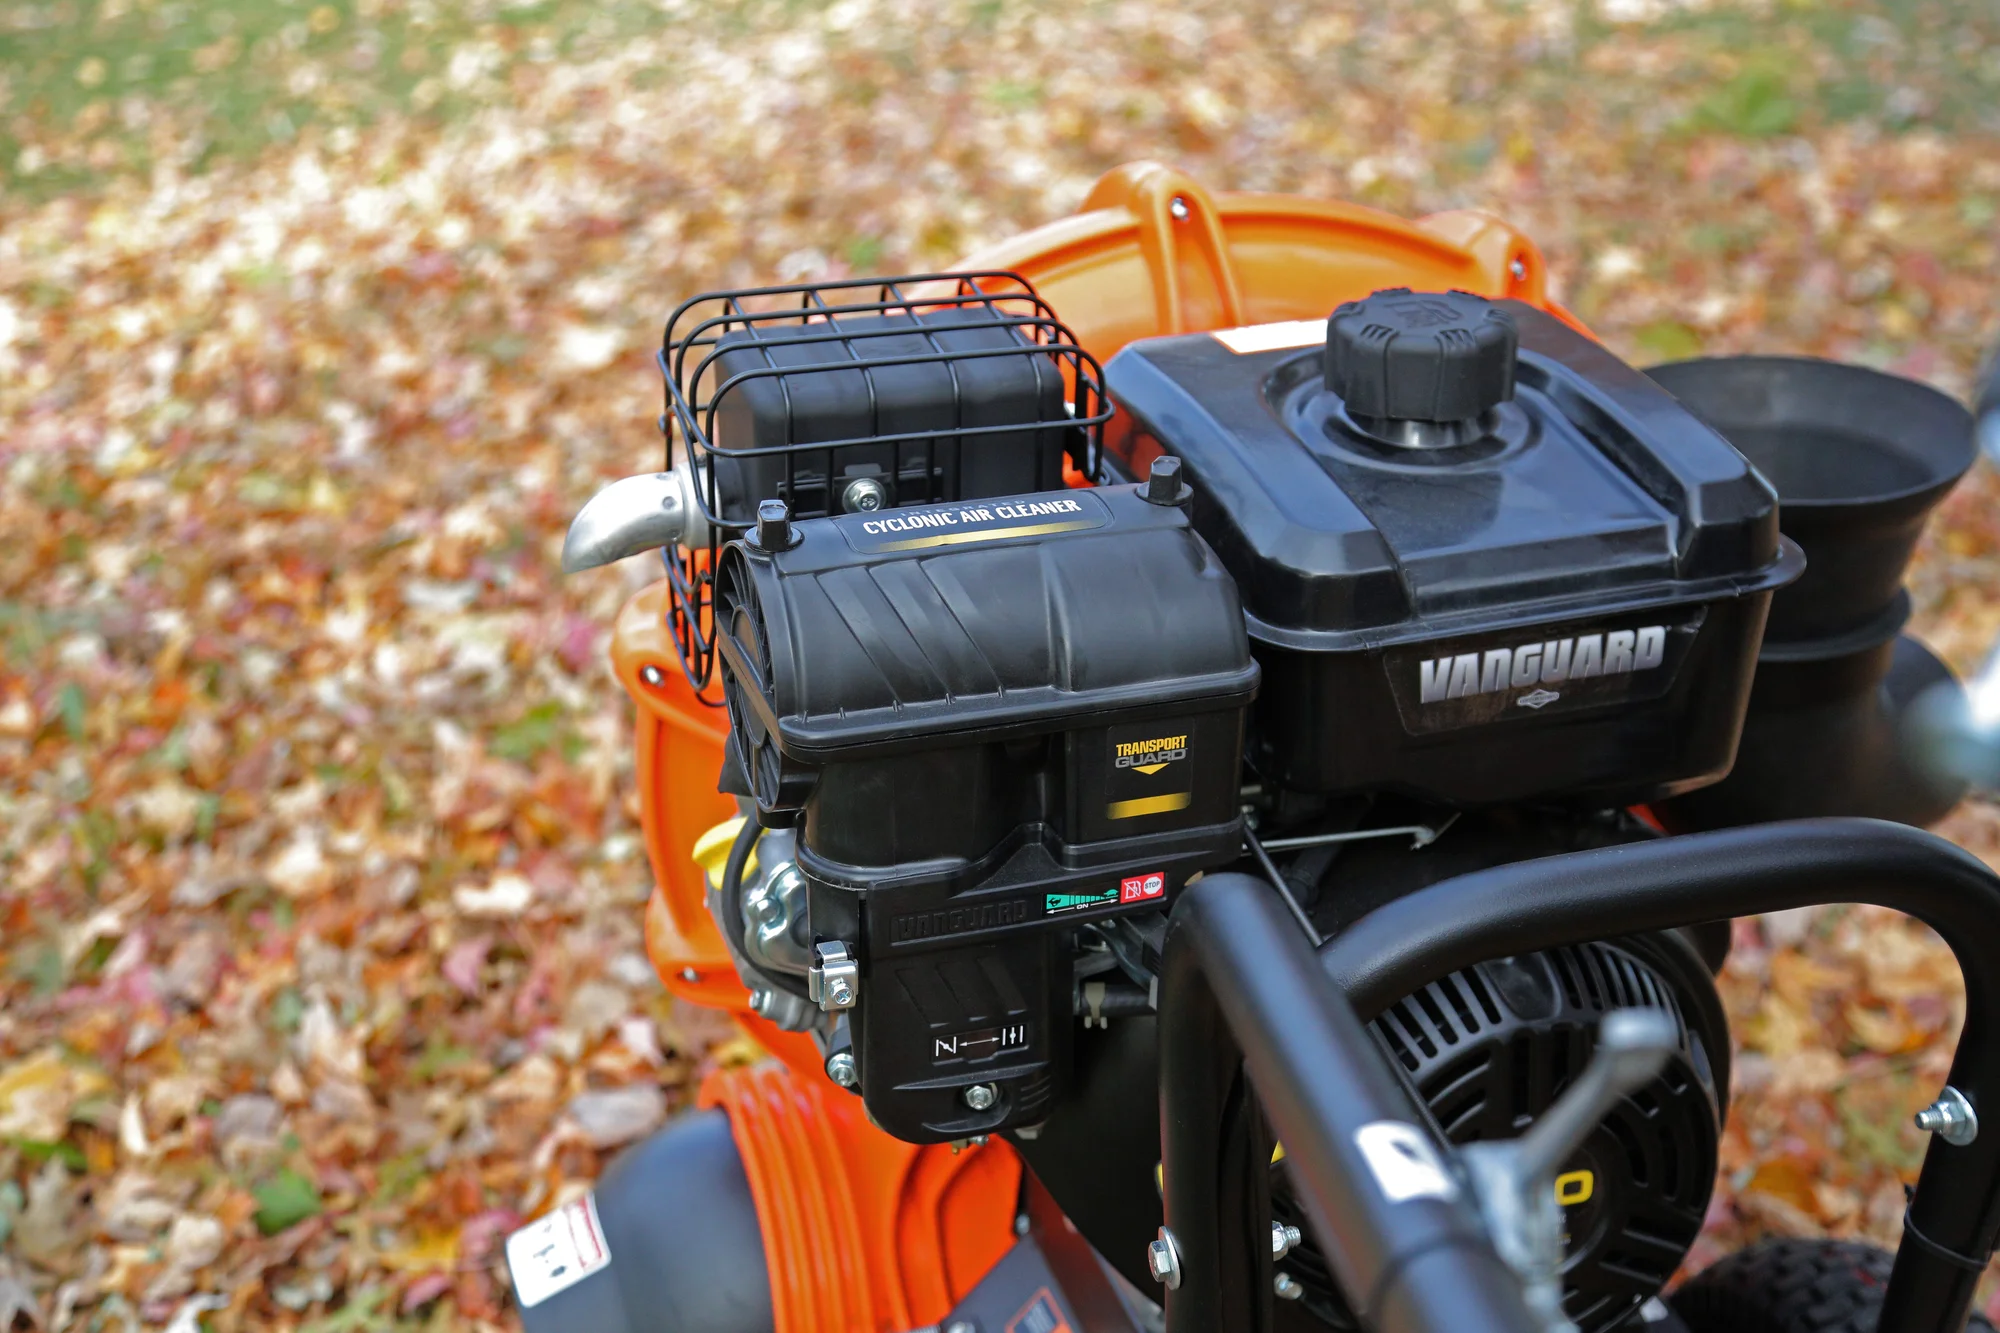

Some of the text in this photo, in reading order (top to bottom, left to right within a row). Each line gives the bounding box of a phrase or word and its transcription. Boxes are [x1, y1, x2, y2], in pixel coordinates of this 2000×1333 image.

[863, 499, 1082, 535] CYCLONIC AIR CLEANER
[1420, 625, 1666, 704] VANGUARD
[1115, 735, 1188, 757] TRANSPORT
[1114, 748, 1187, 769] GUARD
[1144, 880, 1161, 890] STOP
[1076, 902, 1089, 910] ON
[898, 899, 1028, 940] VANGUARD
